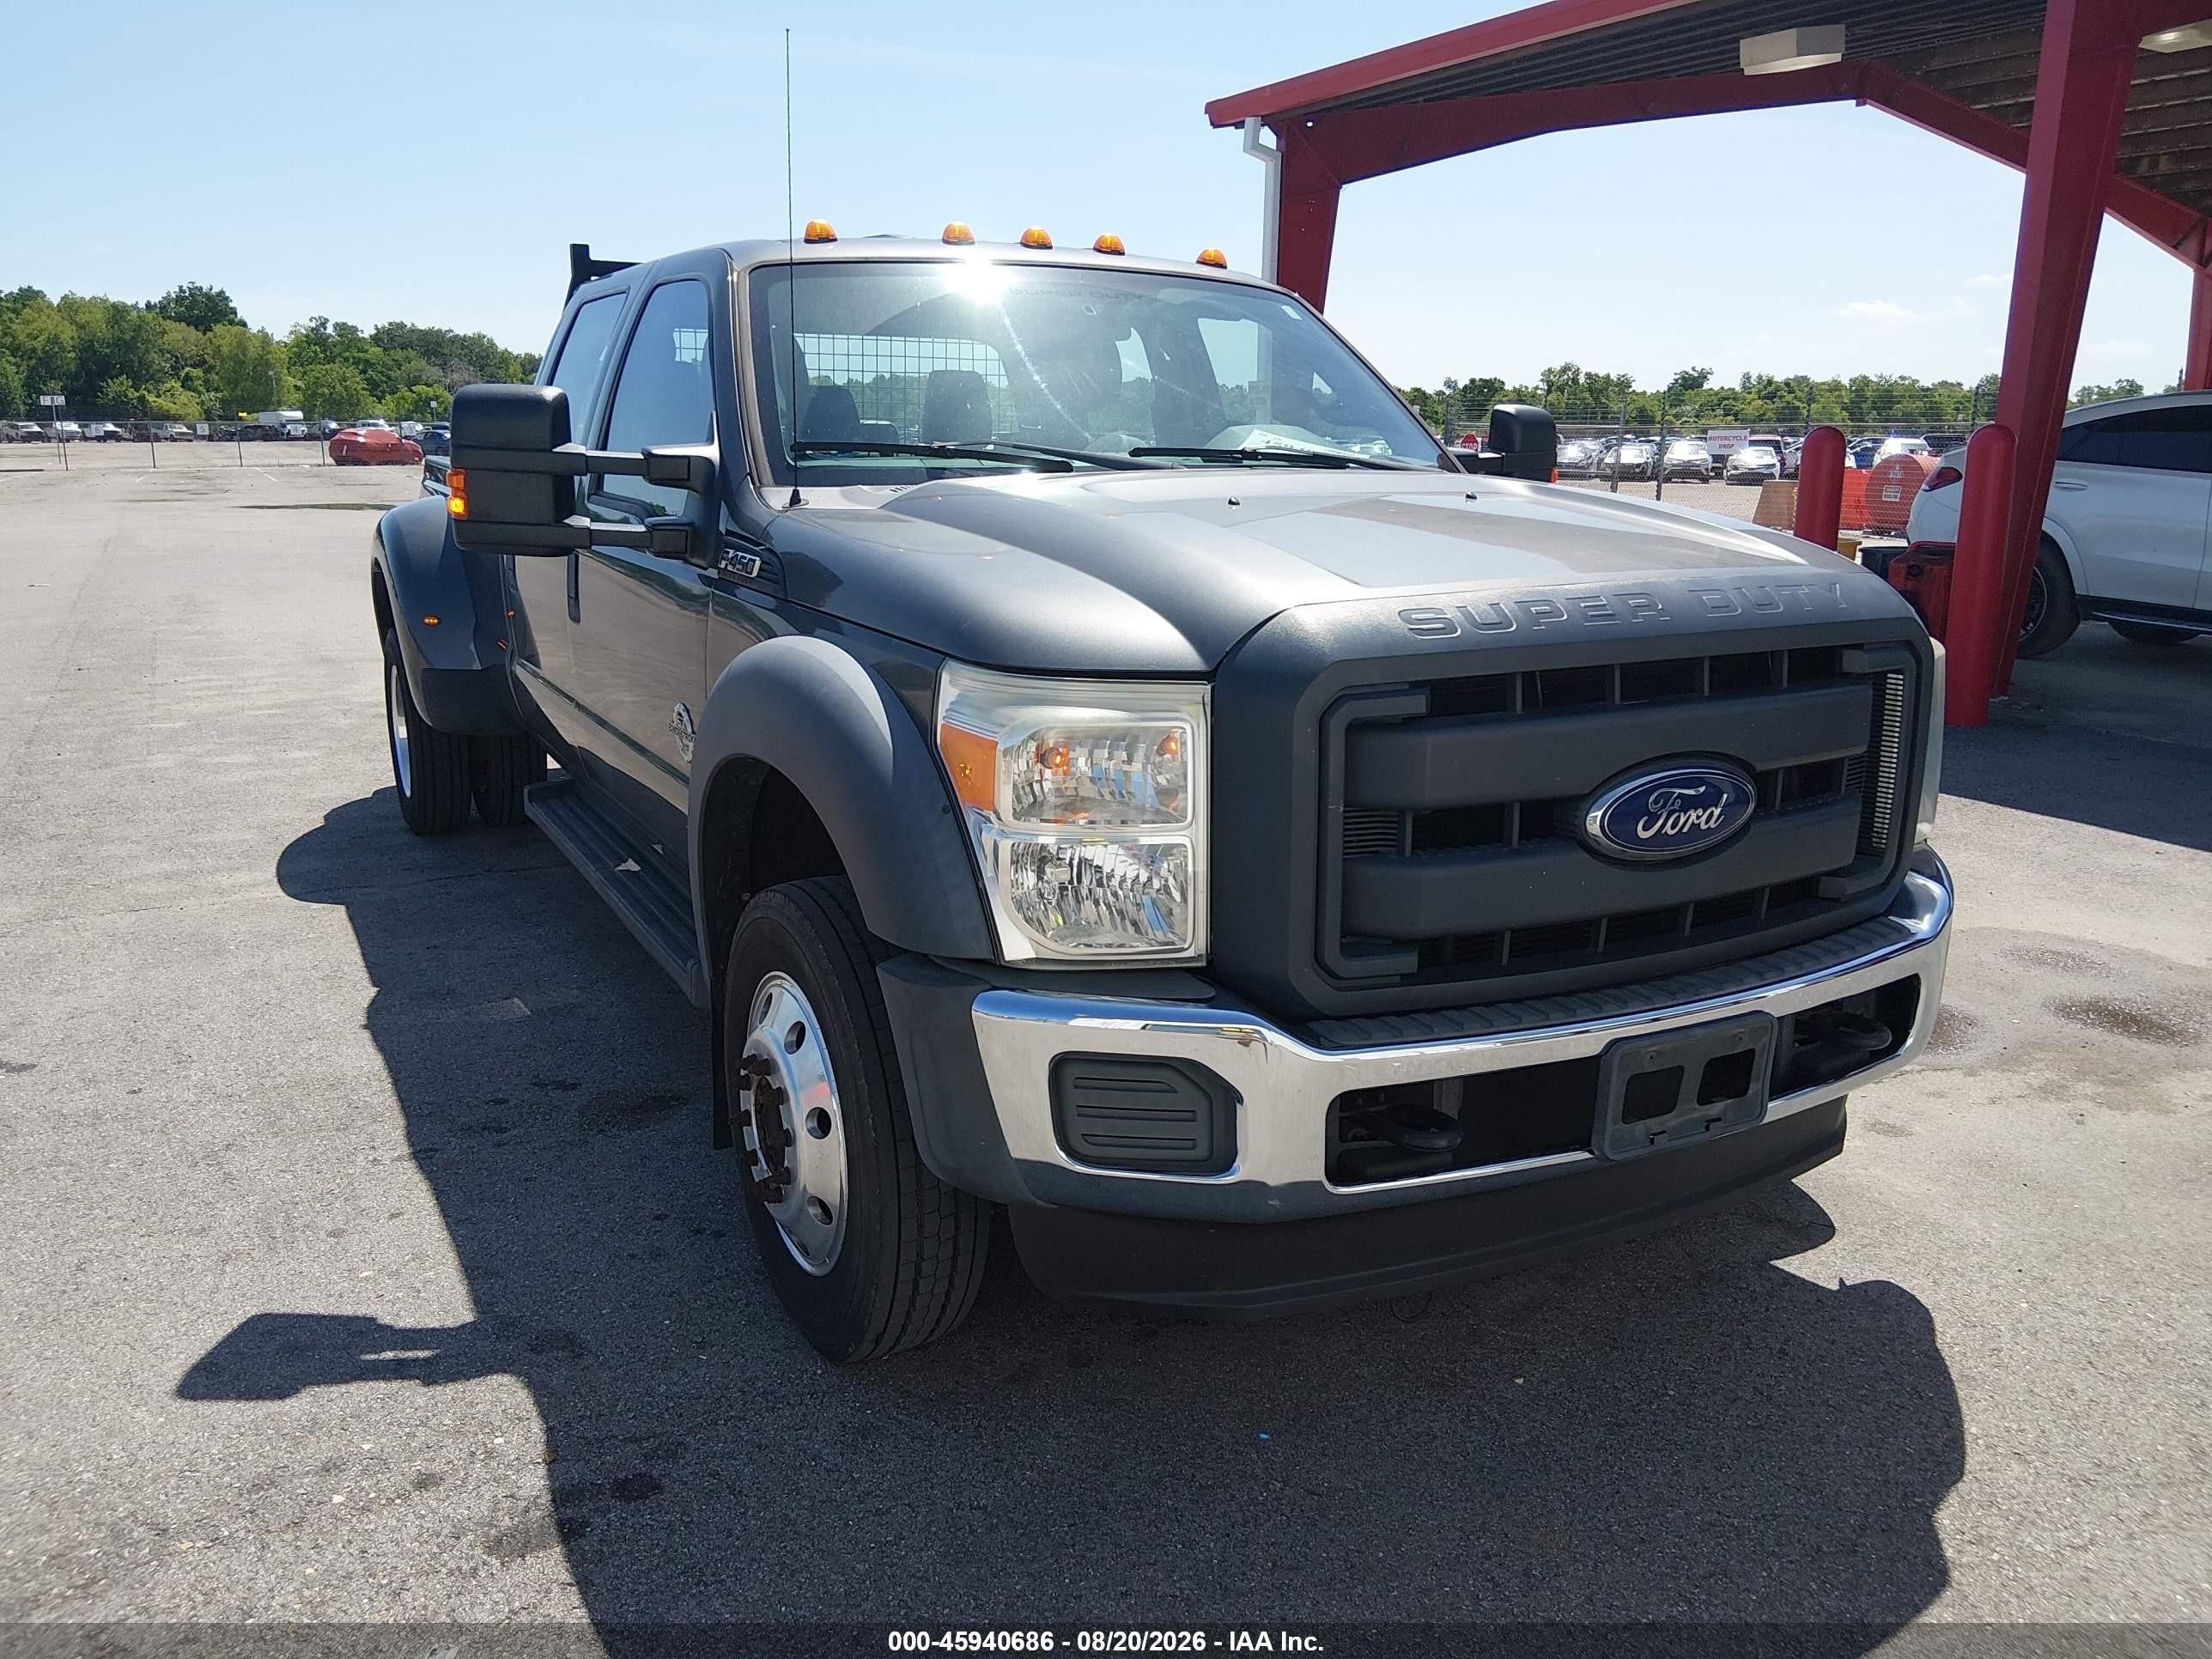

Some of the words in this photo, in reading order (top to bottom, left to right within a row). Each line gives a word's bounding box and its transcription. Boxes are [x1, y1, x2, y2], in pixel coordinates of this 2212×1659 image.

[56, 396, 64, 404] G
[1398, 592, 1671, 640] SUPER
[1688, 582, 1848, 617] DUTY
[1637, 785, 1728, 839] Ford
